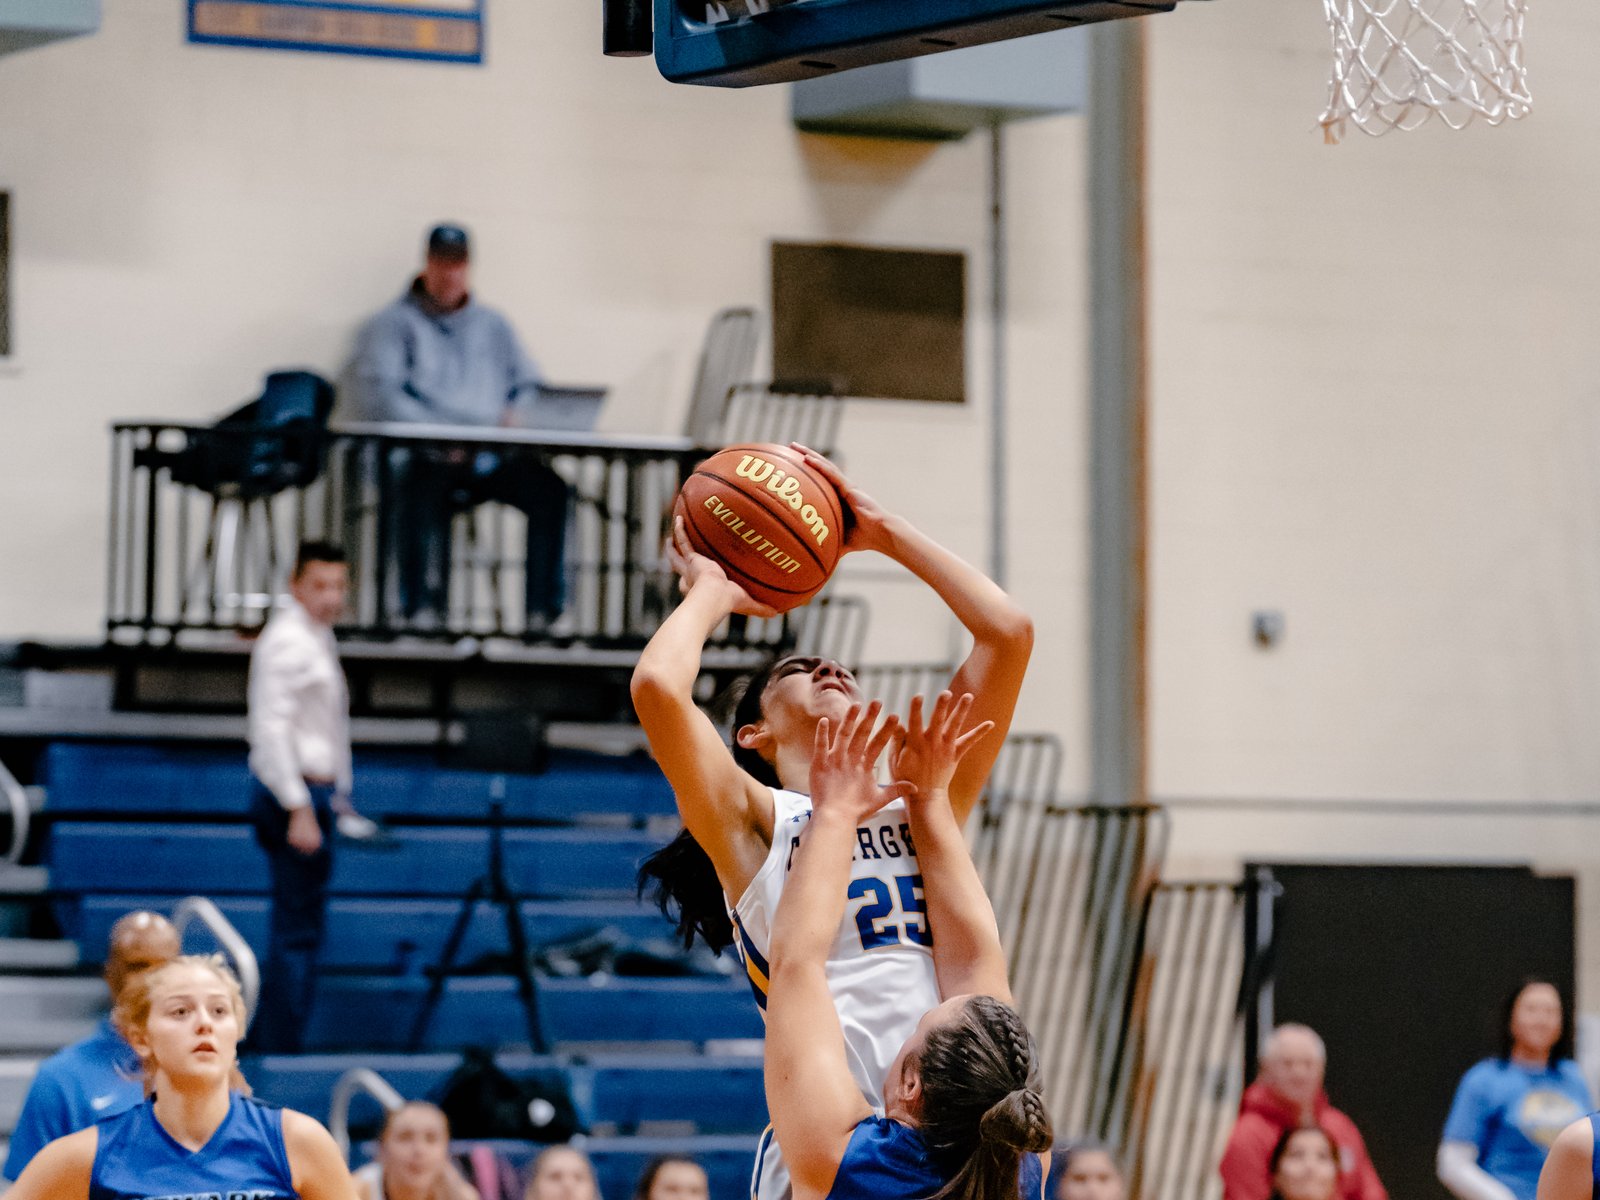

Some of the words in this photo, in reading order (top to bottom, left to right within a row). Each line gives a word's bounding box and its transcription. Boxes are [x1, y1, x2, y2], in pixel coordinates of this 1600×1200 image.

[704, 495, 801, 574] EVOLUTION
[735, 454, 830, 546] Wilson
[847, 873, 934, 950] 25
